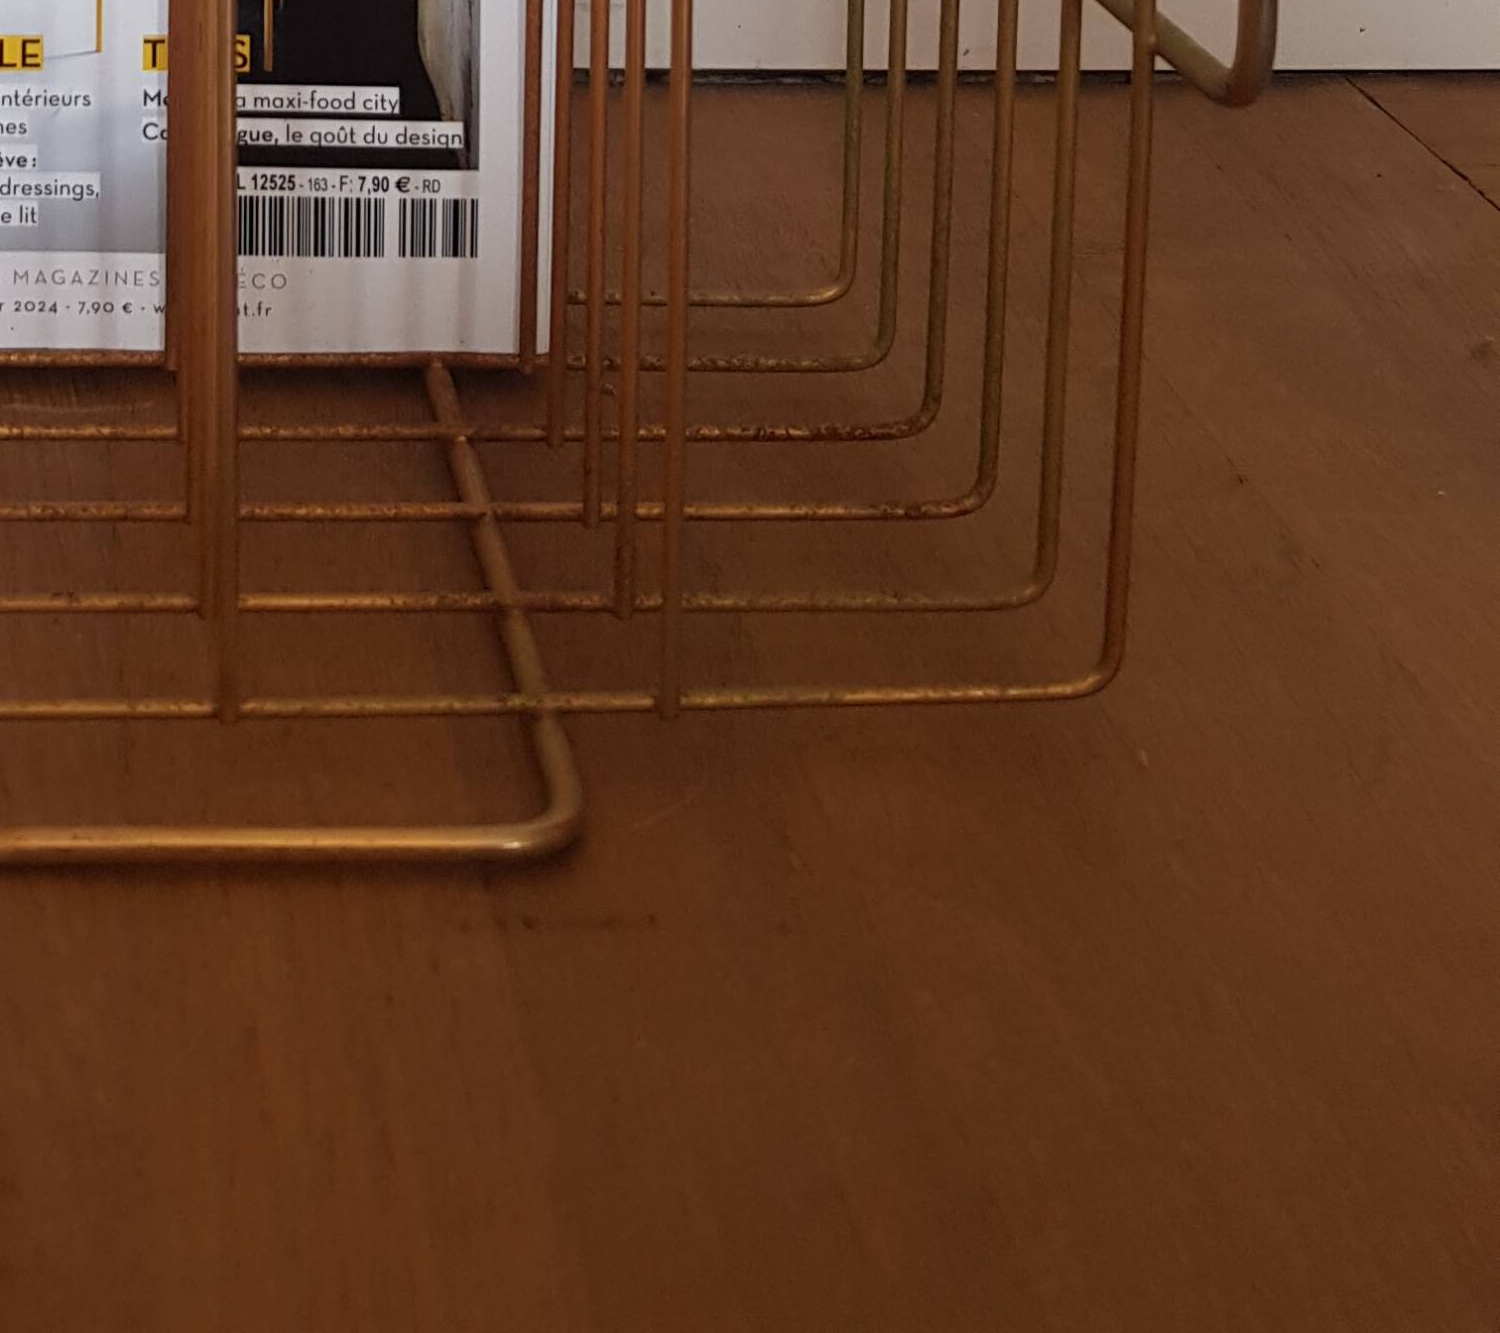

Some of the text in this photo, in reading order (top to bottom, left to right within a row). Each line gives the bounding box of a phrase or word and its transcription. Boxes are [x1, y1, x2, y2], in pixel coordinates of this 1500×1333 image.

[236, 90, 399, 113] a maxi-food city
[286, 124, 303, 143] le
[310, 126, 357, 146] goût
[363, 126, 388, 144] du
[395, 126, 463, 148] design
[0, 177, 100, 201] dressings,
[251, 173, 296, 191] 12525
[307, 176, 328, 192] 163
[357, 175, 390, 195] 7,90
[395, 176, 411, 194] €
[422, 179, 442, 194] RD
[19, 204, 37, 224] lit
[13, 269, 160, 287] MAGAZINES
[14, 301, 58, 314] 2024
[122, 301, 133, 314] €
